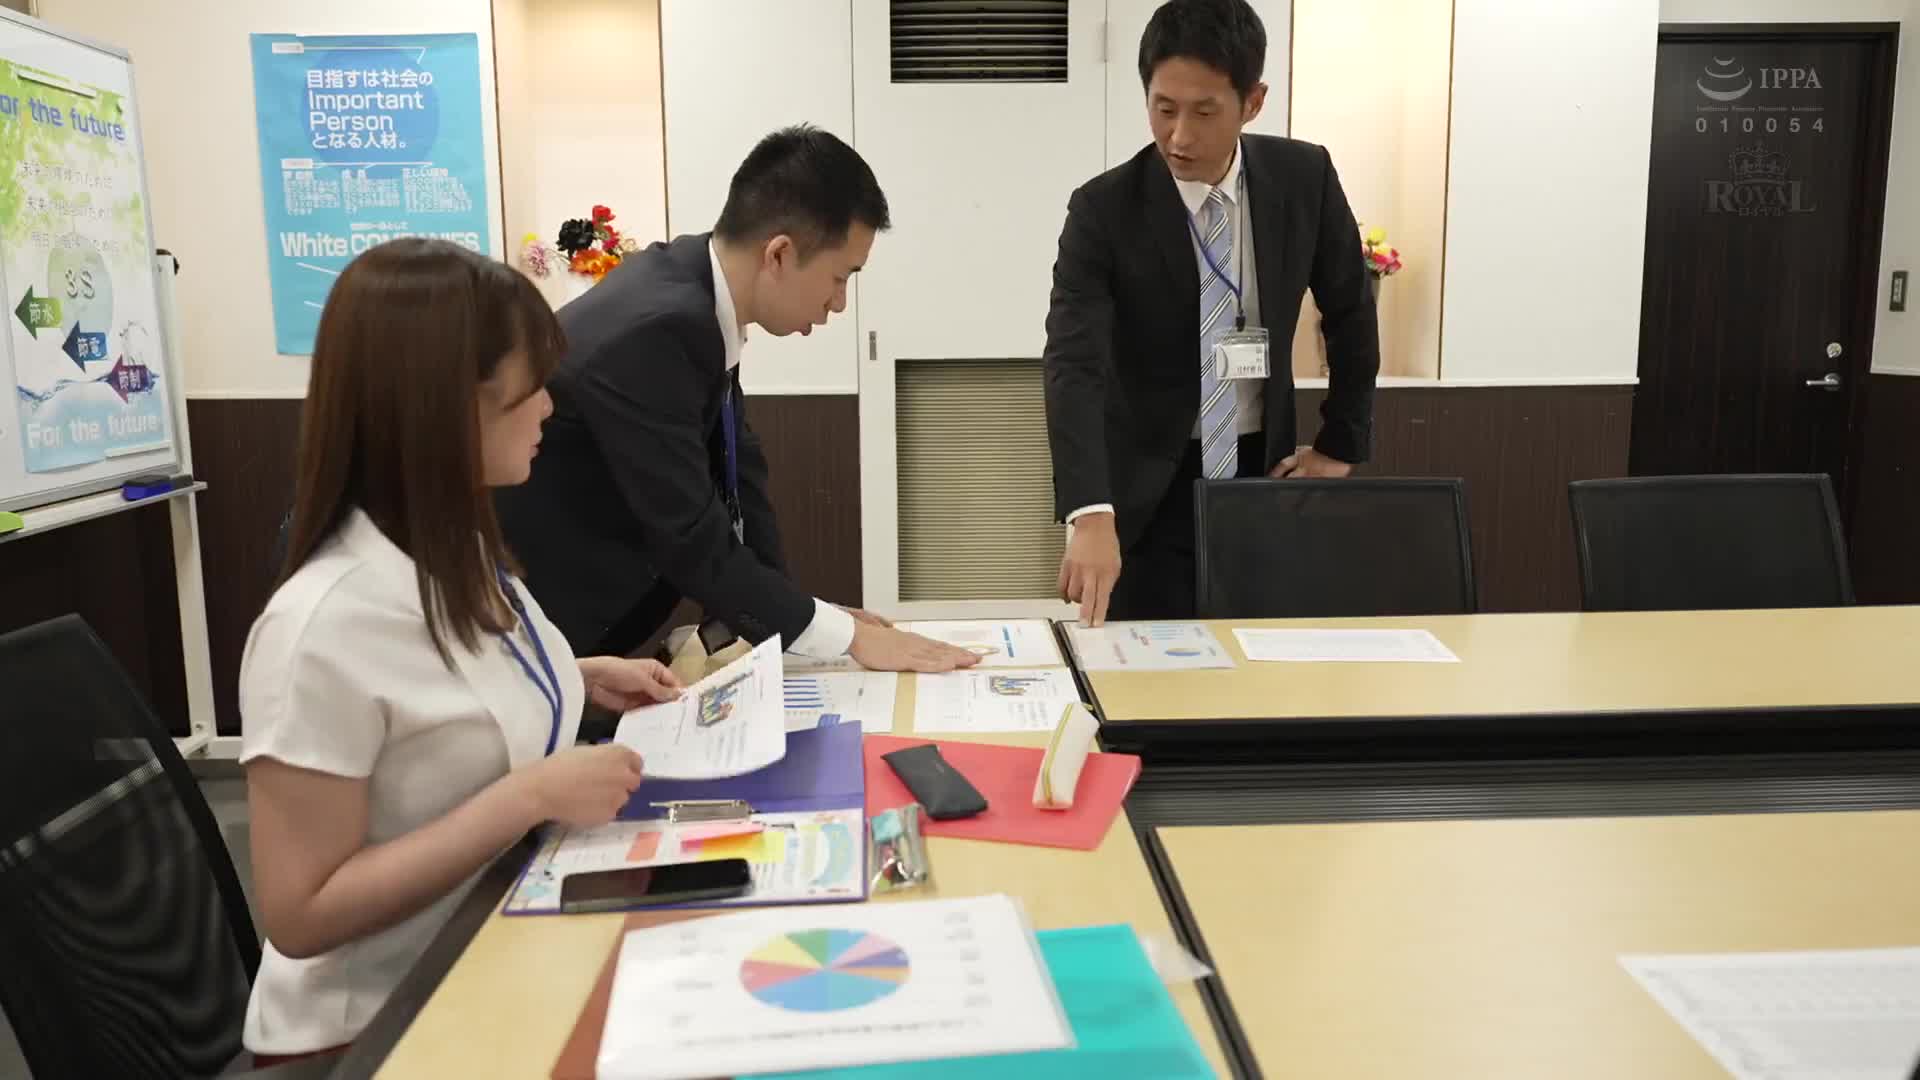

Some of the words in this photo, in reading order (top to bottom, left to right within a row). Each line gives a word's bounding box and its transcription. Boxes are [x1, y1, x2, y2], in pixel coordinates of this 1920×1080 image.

[307, 69, 432, 88] 目指すは社会の
[309, 90, 425, 112] Important
[29, 96, 63, 126] the
[70, 107, 125, 140] future
[310, 112, 392, 131] Person
[312, 132, 406, 149] となる人材。
[280, 231, 347, 257] White
[65, 269, 96, 299] 3S
[29, 303, 55, 322] 節水
[27, 422, 63, 449] For
[70, 418, 99, 442] the
[106, 414, 160, 438] future
